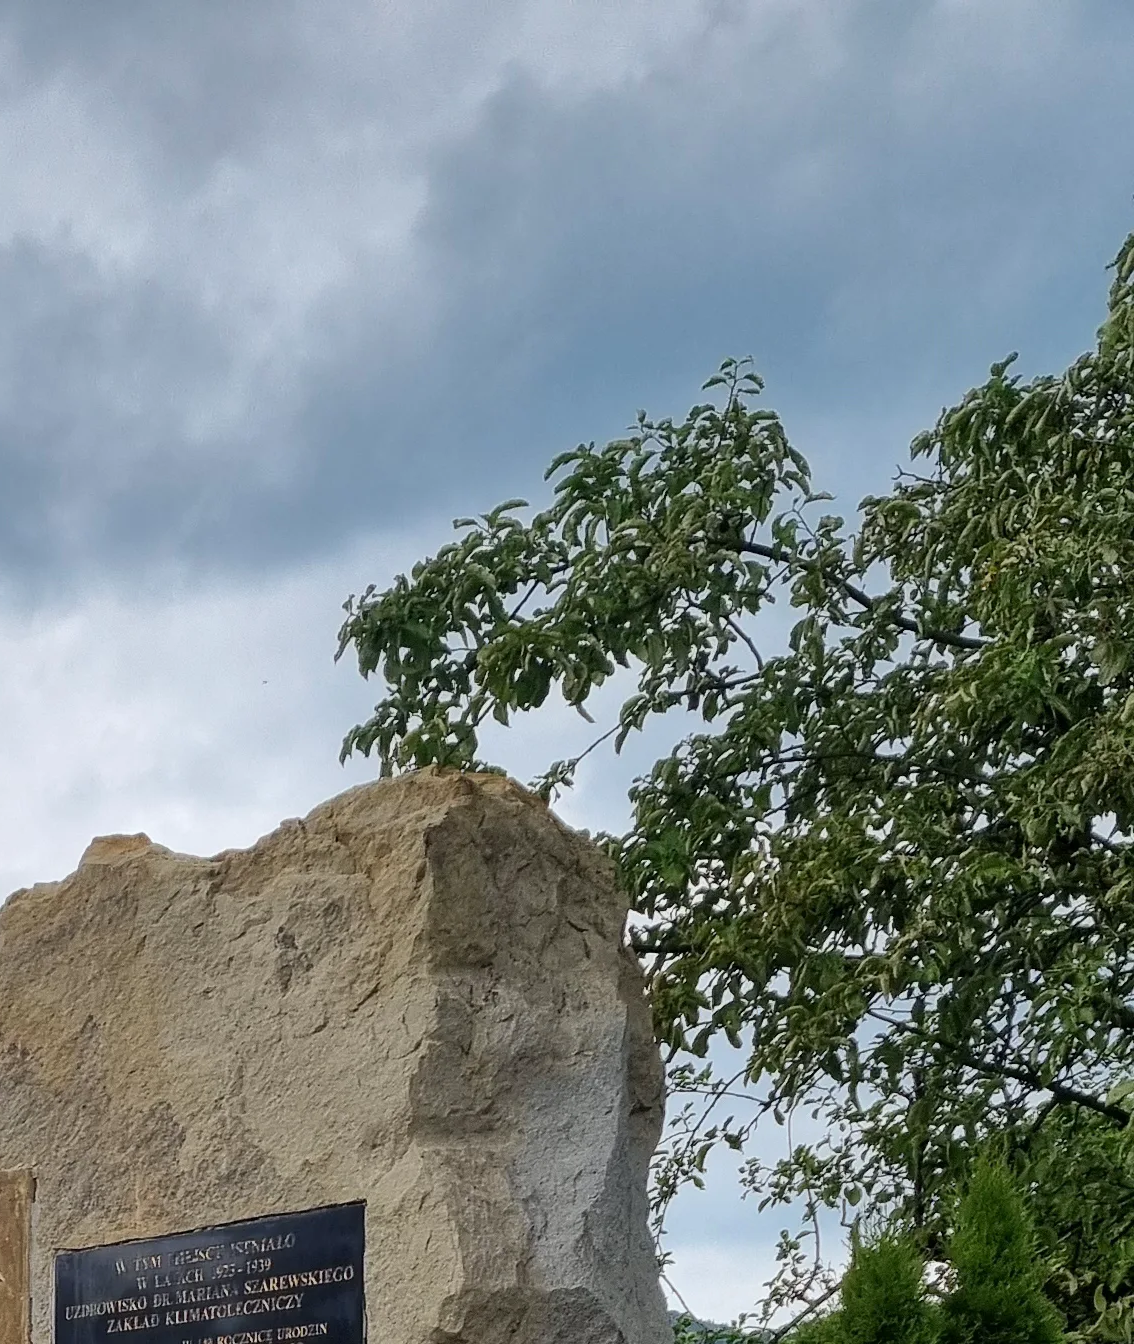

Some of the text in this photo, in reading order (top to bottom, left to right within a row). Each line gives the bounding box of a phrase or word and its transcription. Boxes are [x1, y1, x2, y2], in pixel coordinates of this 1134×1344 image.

[133, 1254, 162, 1272] TYM
[154, 1268, 204, 1288] LAACH
[65, 1296, 147, 1321] UZDROWISKO
[244, 1265, 355, 1295] SZAREWSKIEGO
[165, 1293, 304, 1326] KLIMATOLECZNICZY
[277, 1322, 328, 1340] URODZIN
